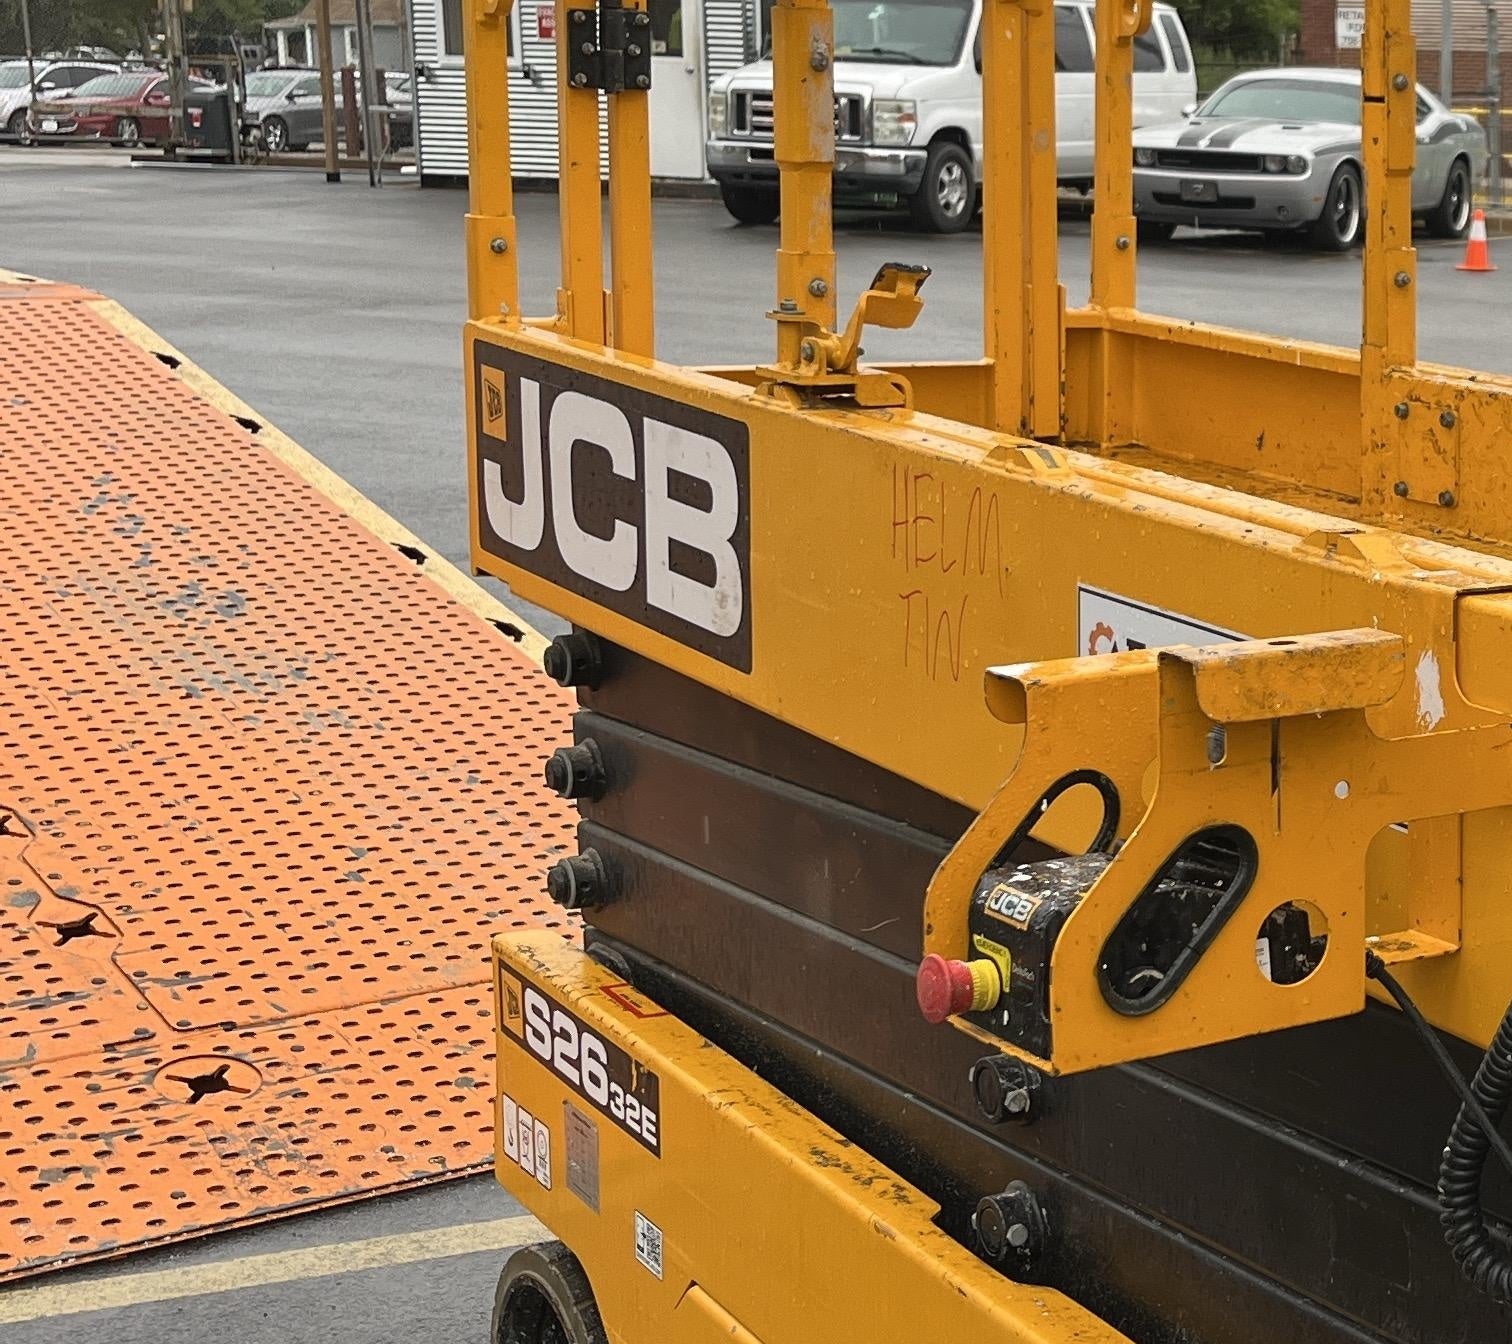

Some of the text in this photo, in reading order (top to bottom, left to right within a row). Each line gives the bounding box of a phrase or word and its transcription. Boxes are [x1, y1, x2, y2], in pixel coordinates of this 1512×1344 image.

[483, 376, 743, 638] JCB
[892, 462, 1004, 600] HELM
[989, 891, 1034, 922] JCB
